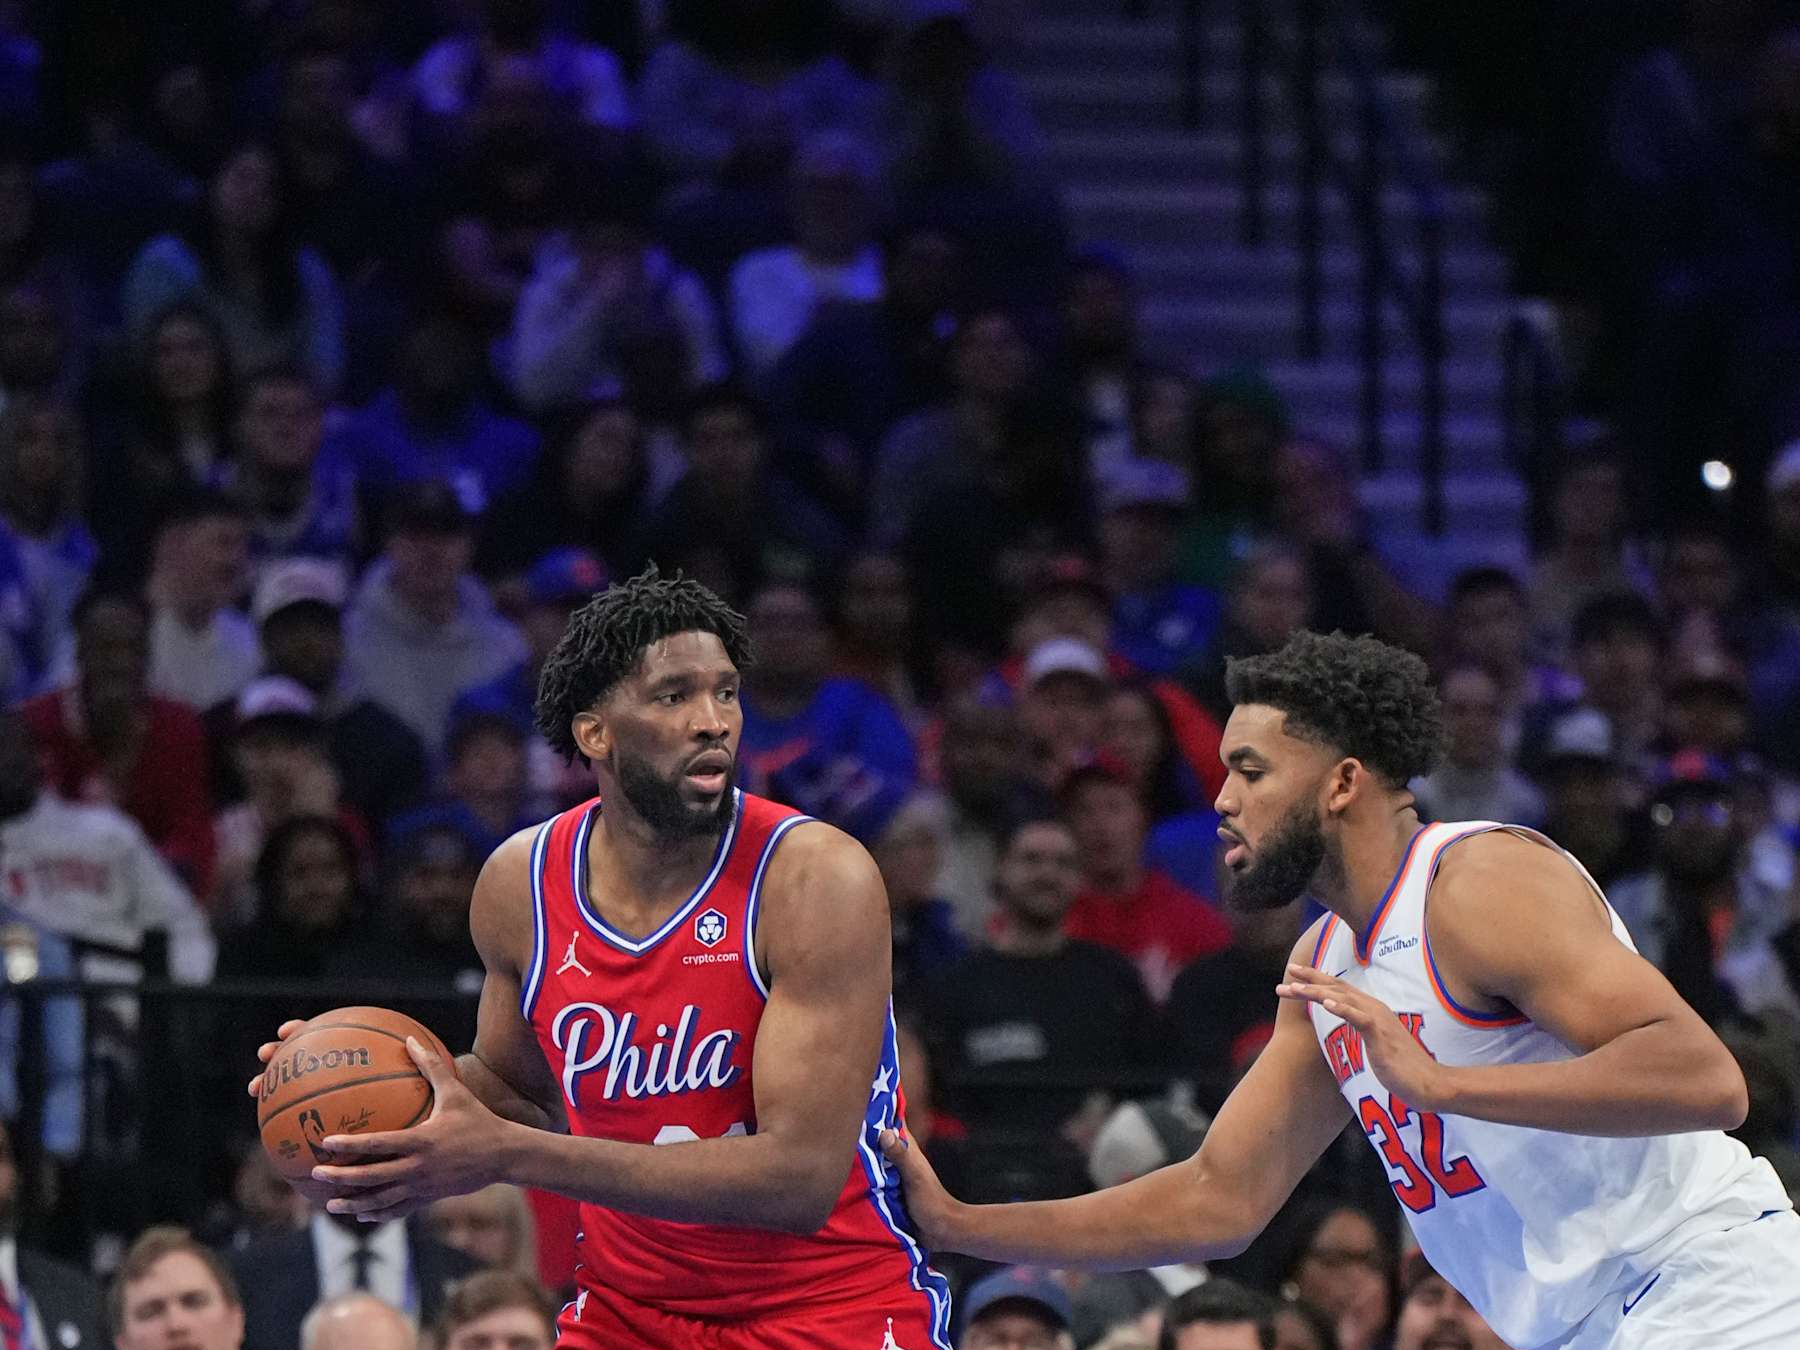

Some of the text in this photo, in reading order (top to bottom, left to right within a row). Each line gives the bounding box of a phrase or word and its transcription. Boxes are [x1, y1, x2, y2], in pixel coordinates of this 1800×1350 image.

[682, 952, 739, 965] crypto.com
[258, 1046, 371, 1103] Wilson
[552, 1002, 743, 1109] Phila
[1359, 1092, 1487, 1214] 32
